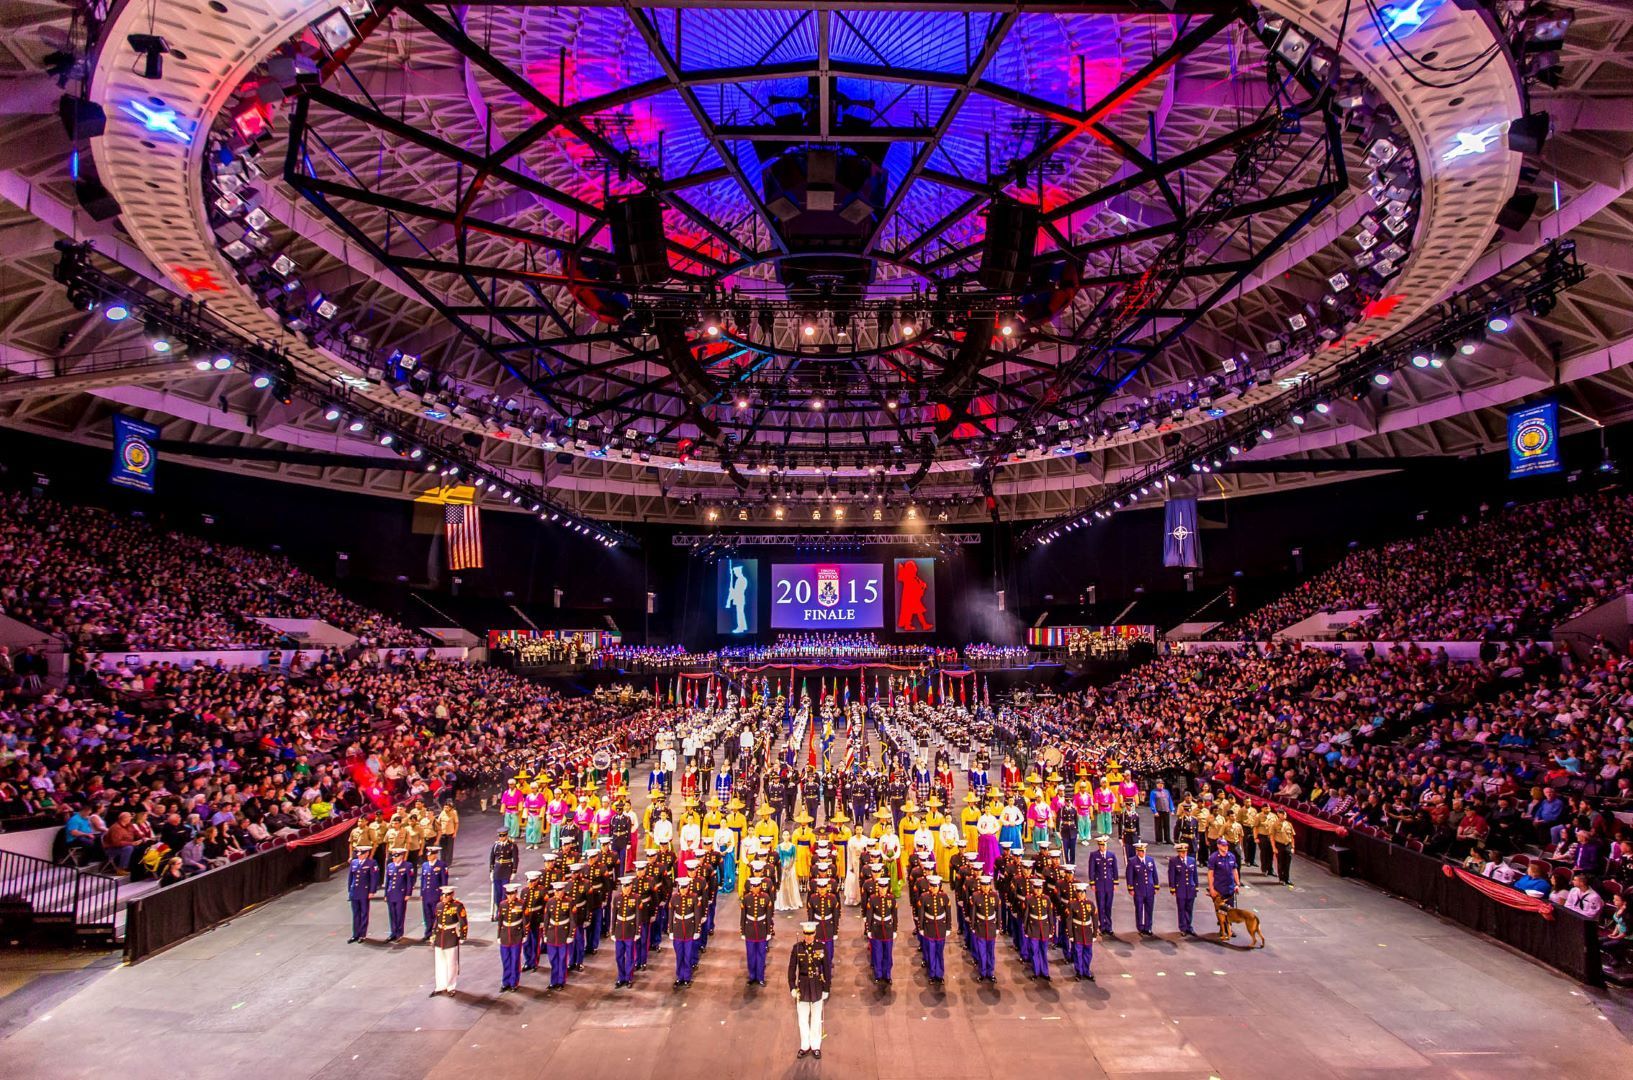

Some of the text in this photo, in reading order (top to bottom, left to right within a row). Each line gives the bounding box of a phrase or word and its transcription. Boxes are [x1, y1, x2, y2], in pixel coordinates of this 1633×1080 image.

[776, 579, 877, 603] 20 15
[804, 609, 855, 620] FINALE
